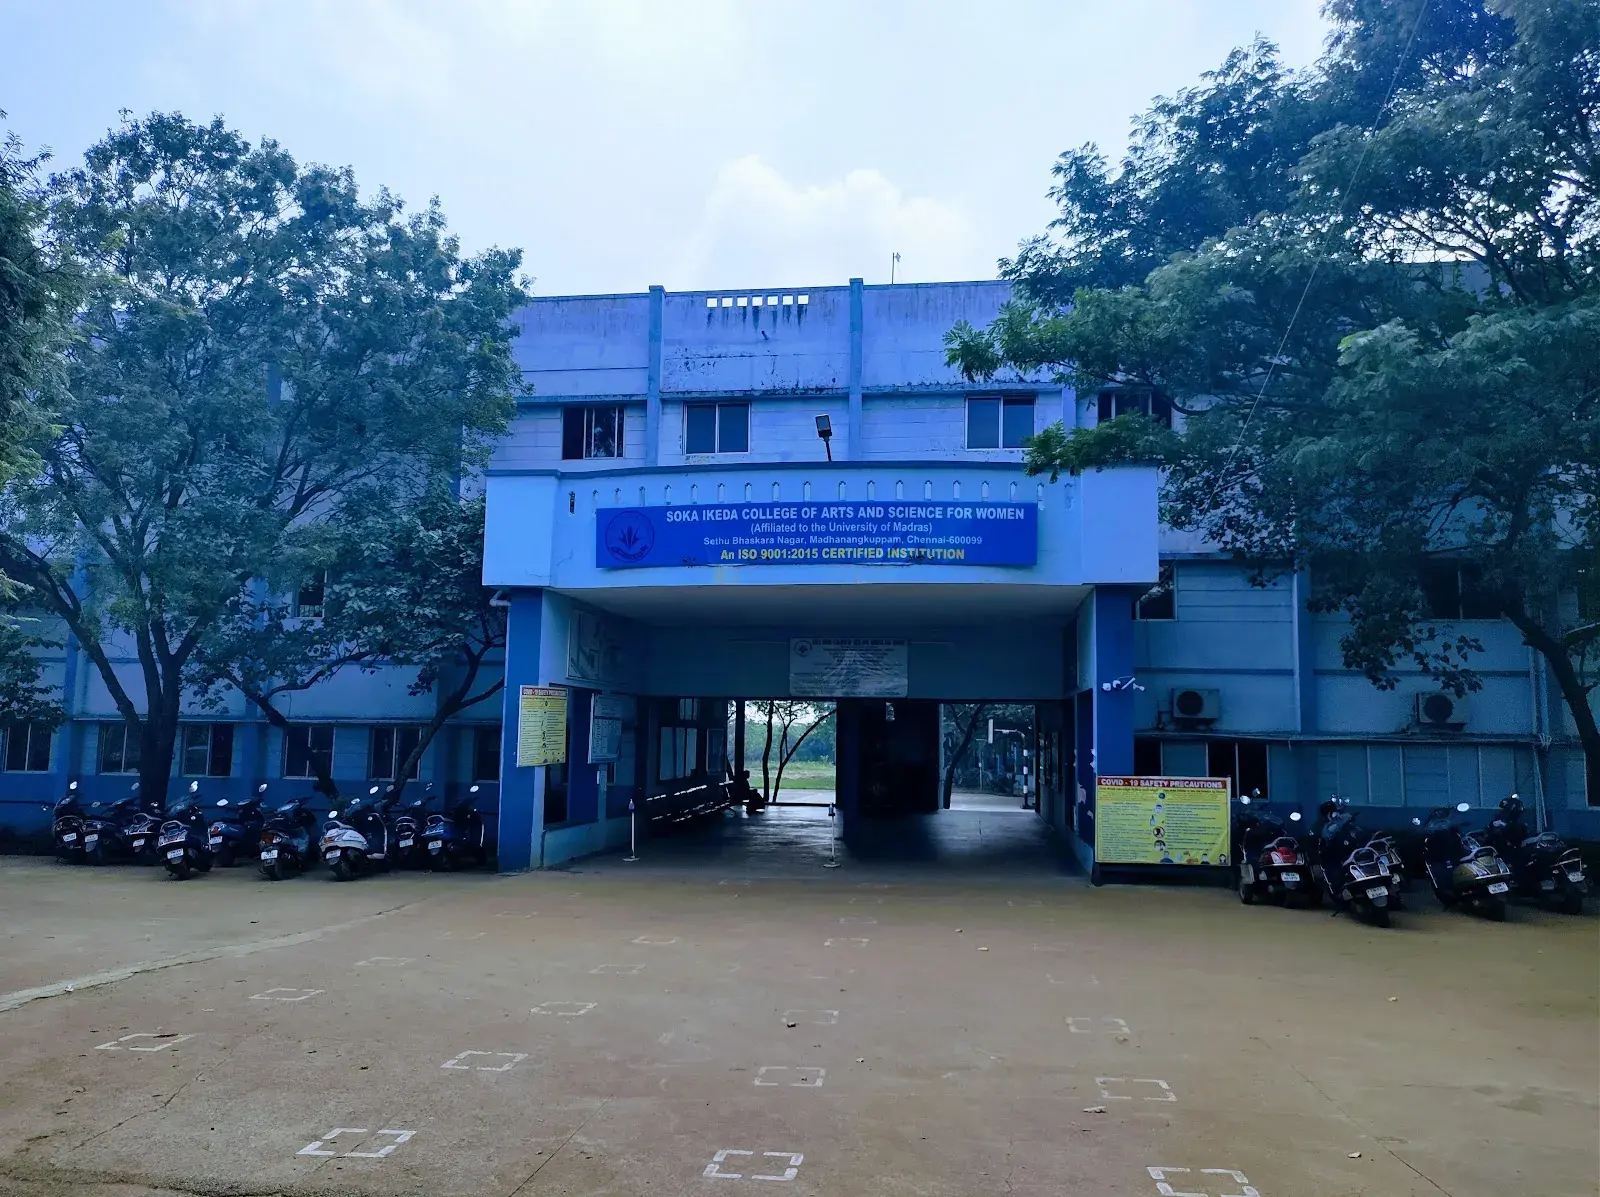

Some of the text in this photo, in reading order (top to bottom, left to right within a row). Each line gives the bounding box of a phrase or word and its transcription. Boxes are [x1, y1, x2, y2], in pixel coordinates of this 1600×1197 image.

[666, 506, 1025, 522] SOKA IKEDA COLLEGE OF ARTS AND SCIENCE FOR WOMEN
[750, 521, 933, 534] (Affiliated to the University of Madras)
[703, 535, 983, 547] Sethu Bhaskara Nagar, Madhanangkuppam, Chennai-600099
[720, 547, 965, 560] An ISO 9001:2015 CERTIFIED INSTITUTION
[1101, 778, 1124, 786] COVID
[1170, 780, 1223, 788] PRECAUTIONS
